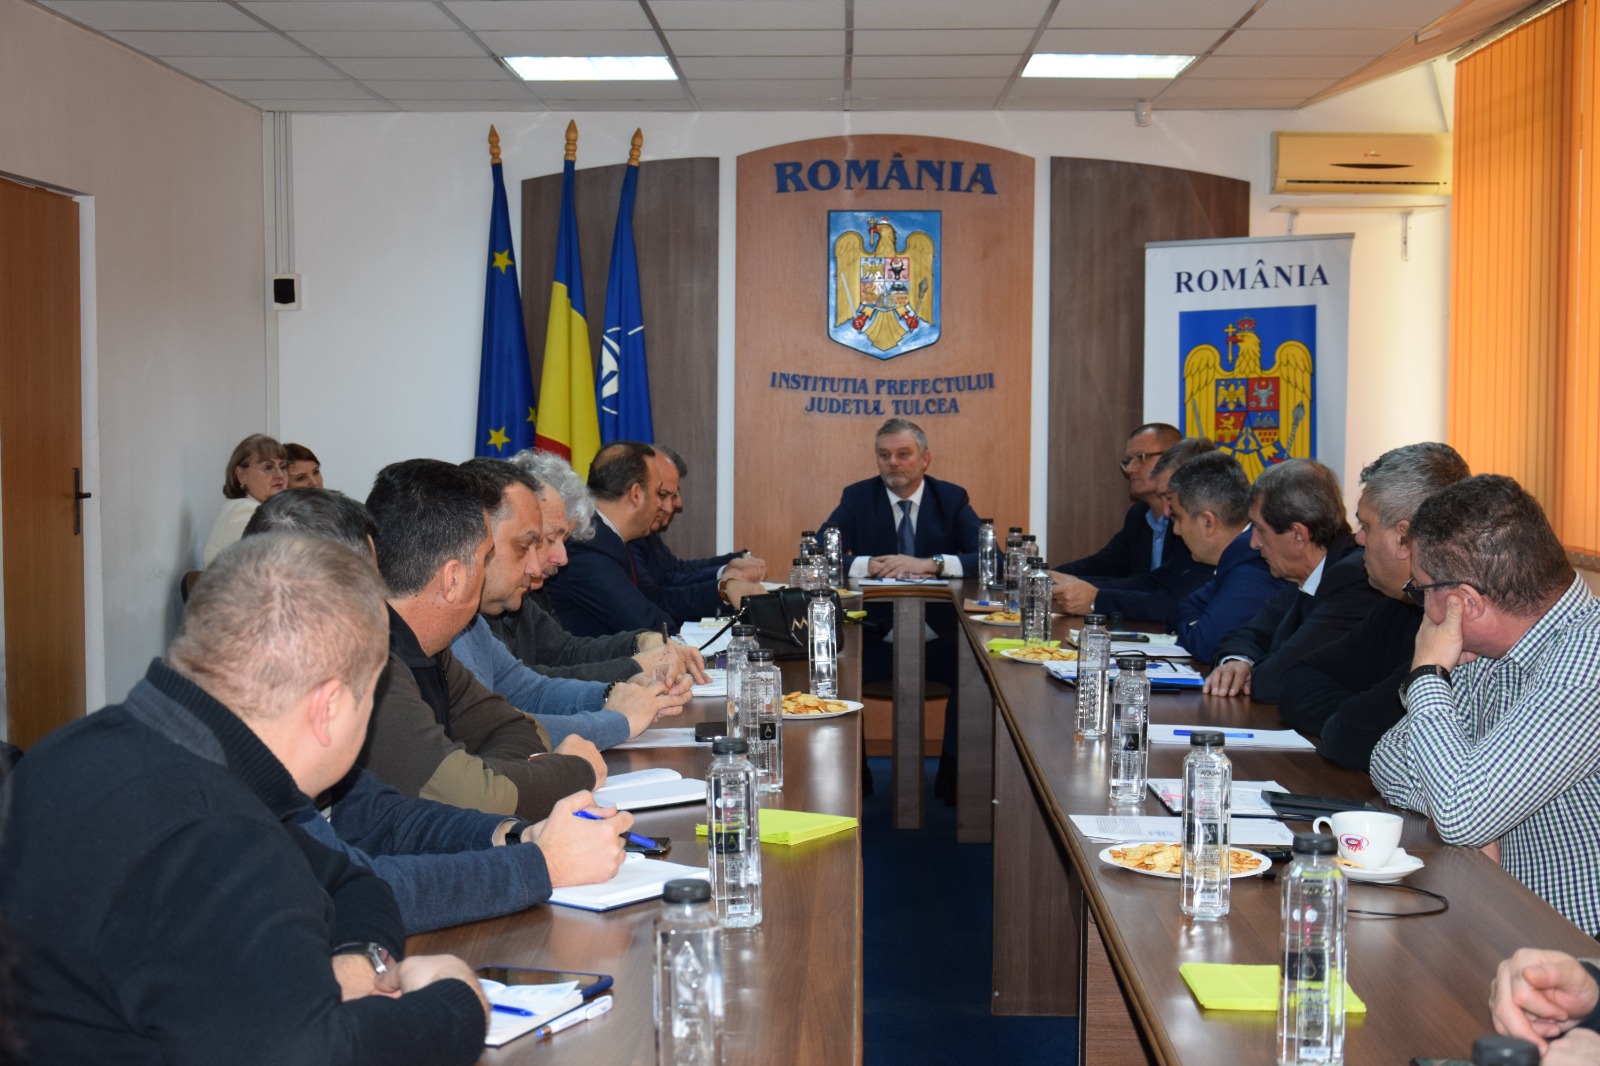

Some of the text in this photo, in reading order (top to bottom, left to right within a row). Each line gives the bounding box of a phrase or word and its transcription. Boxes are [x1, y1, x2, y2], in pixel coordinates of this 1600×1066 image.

[773, 152, 998, 195] ROMÂNIA
[1174, 258, 1329, 293] ROMÂNIA
[769, 371, 995, 396] INSTITUTIA PREFECTULUI
[804, 397, 960, 415] JUDETUL TULCEA
